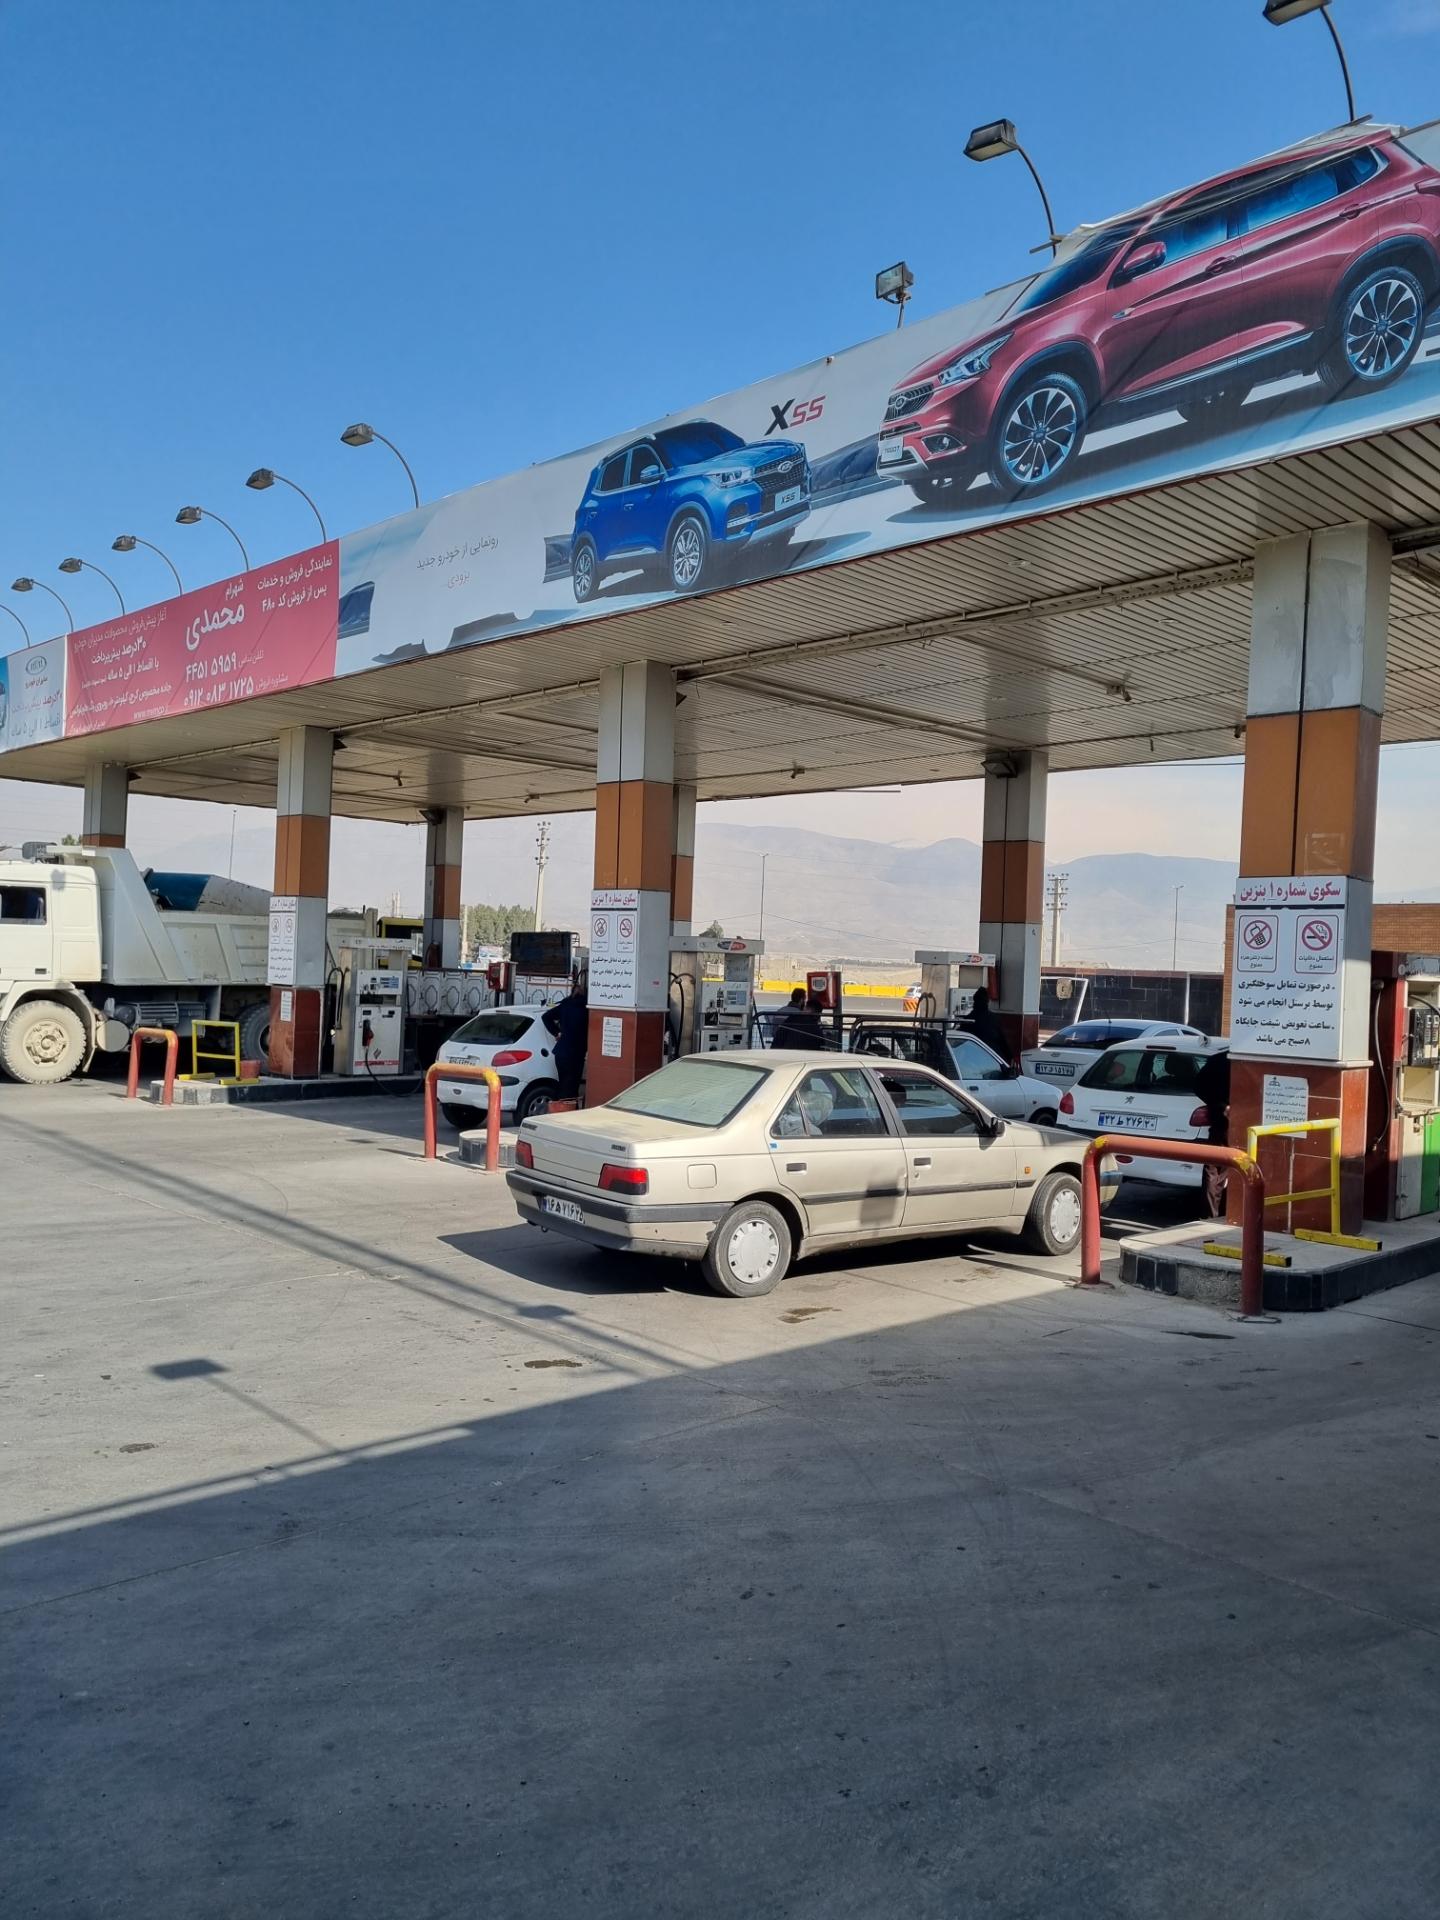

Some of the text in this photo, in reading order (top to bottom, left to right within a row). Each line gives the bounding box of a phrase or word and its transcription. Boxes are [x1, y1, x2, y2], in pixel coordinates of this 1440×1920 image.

[416, 536, 499, 570] رونمایی از خودرو جدید
[257, 554, 333, 590] نمایندگی فروش و خدمات
[225, 577, 244, 601] شهرام
[287, 587, 306, 608] فروش
[313, 584, 327, 599] پس
[278, 592, 287, 607] کد
[186, 603, 245, 650] محمدی
[210, 651, 237, 676] ۵۹۵۹
[184, 687, 203, 706] ۰۹۱۲
[206, 682, 226, 703] ۰۸۳
[229, 676, 254, 699] ۱۷۲۵
[1240, 883, 1266, 901] بنزین
[1277, 881, 1307, 901] شماره
[1309, 881, 1341, 901] سکوی
[1238, 979, 1275, 990] سوختگیری
[1276, 980, 1297, 991] تمایل
[1238, 997, 1333, 1011] توسط پرسنل انجام می شود
[1235, 1017, 1330, 1031] ساعت تعویض شیفت جایگاه
[1256, 1034, 1273, 1043] باشد
[1274, 1038, 1286, 1046] می
